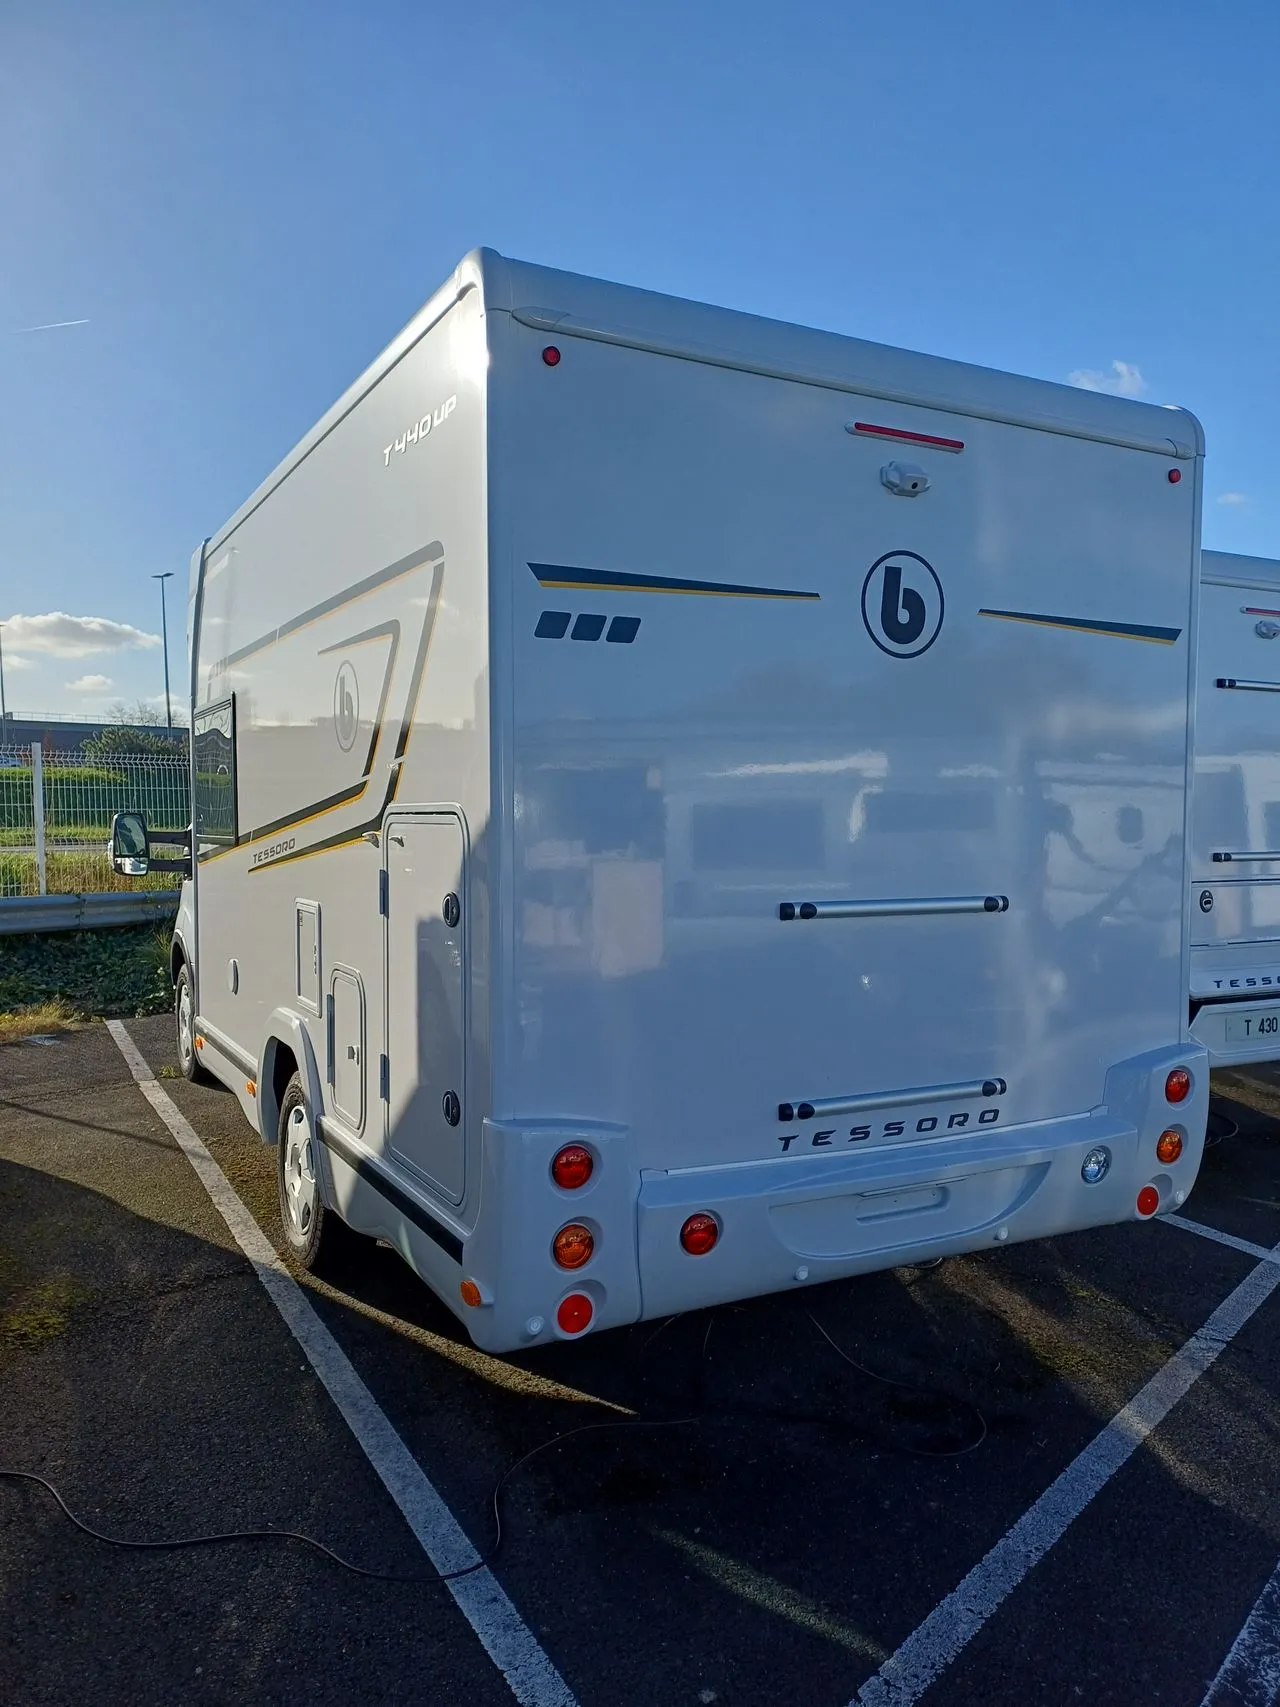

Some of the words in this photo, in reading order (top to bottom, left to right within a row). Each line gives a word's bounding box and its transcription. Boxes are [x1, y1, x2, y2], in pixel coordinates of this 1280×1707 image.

[253, 838, 296, 864] TESSORO
[1213, 976, 1280, 989] TESS
[1244, 1019, 1252, 1036] T
[1258, 1017, 1278, 1034] 430
[778, 1108, 1000, 1152] TESSORO
